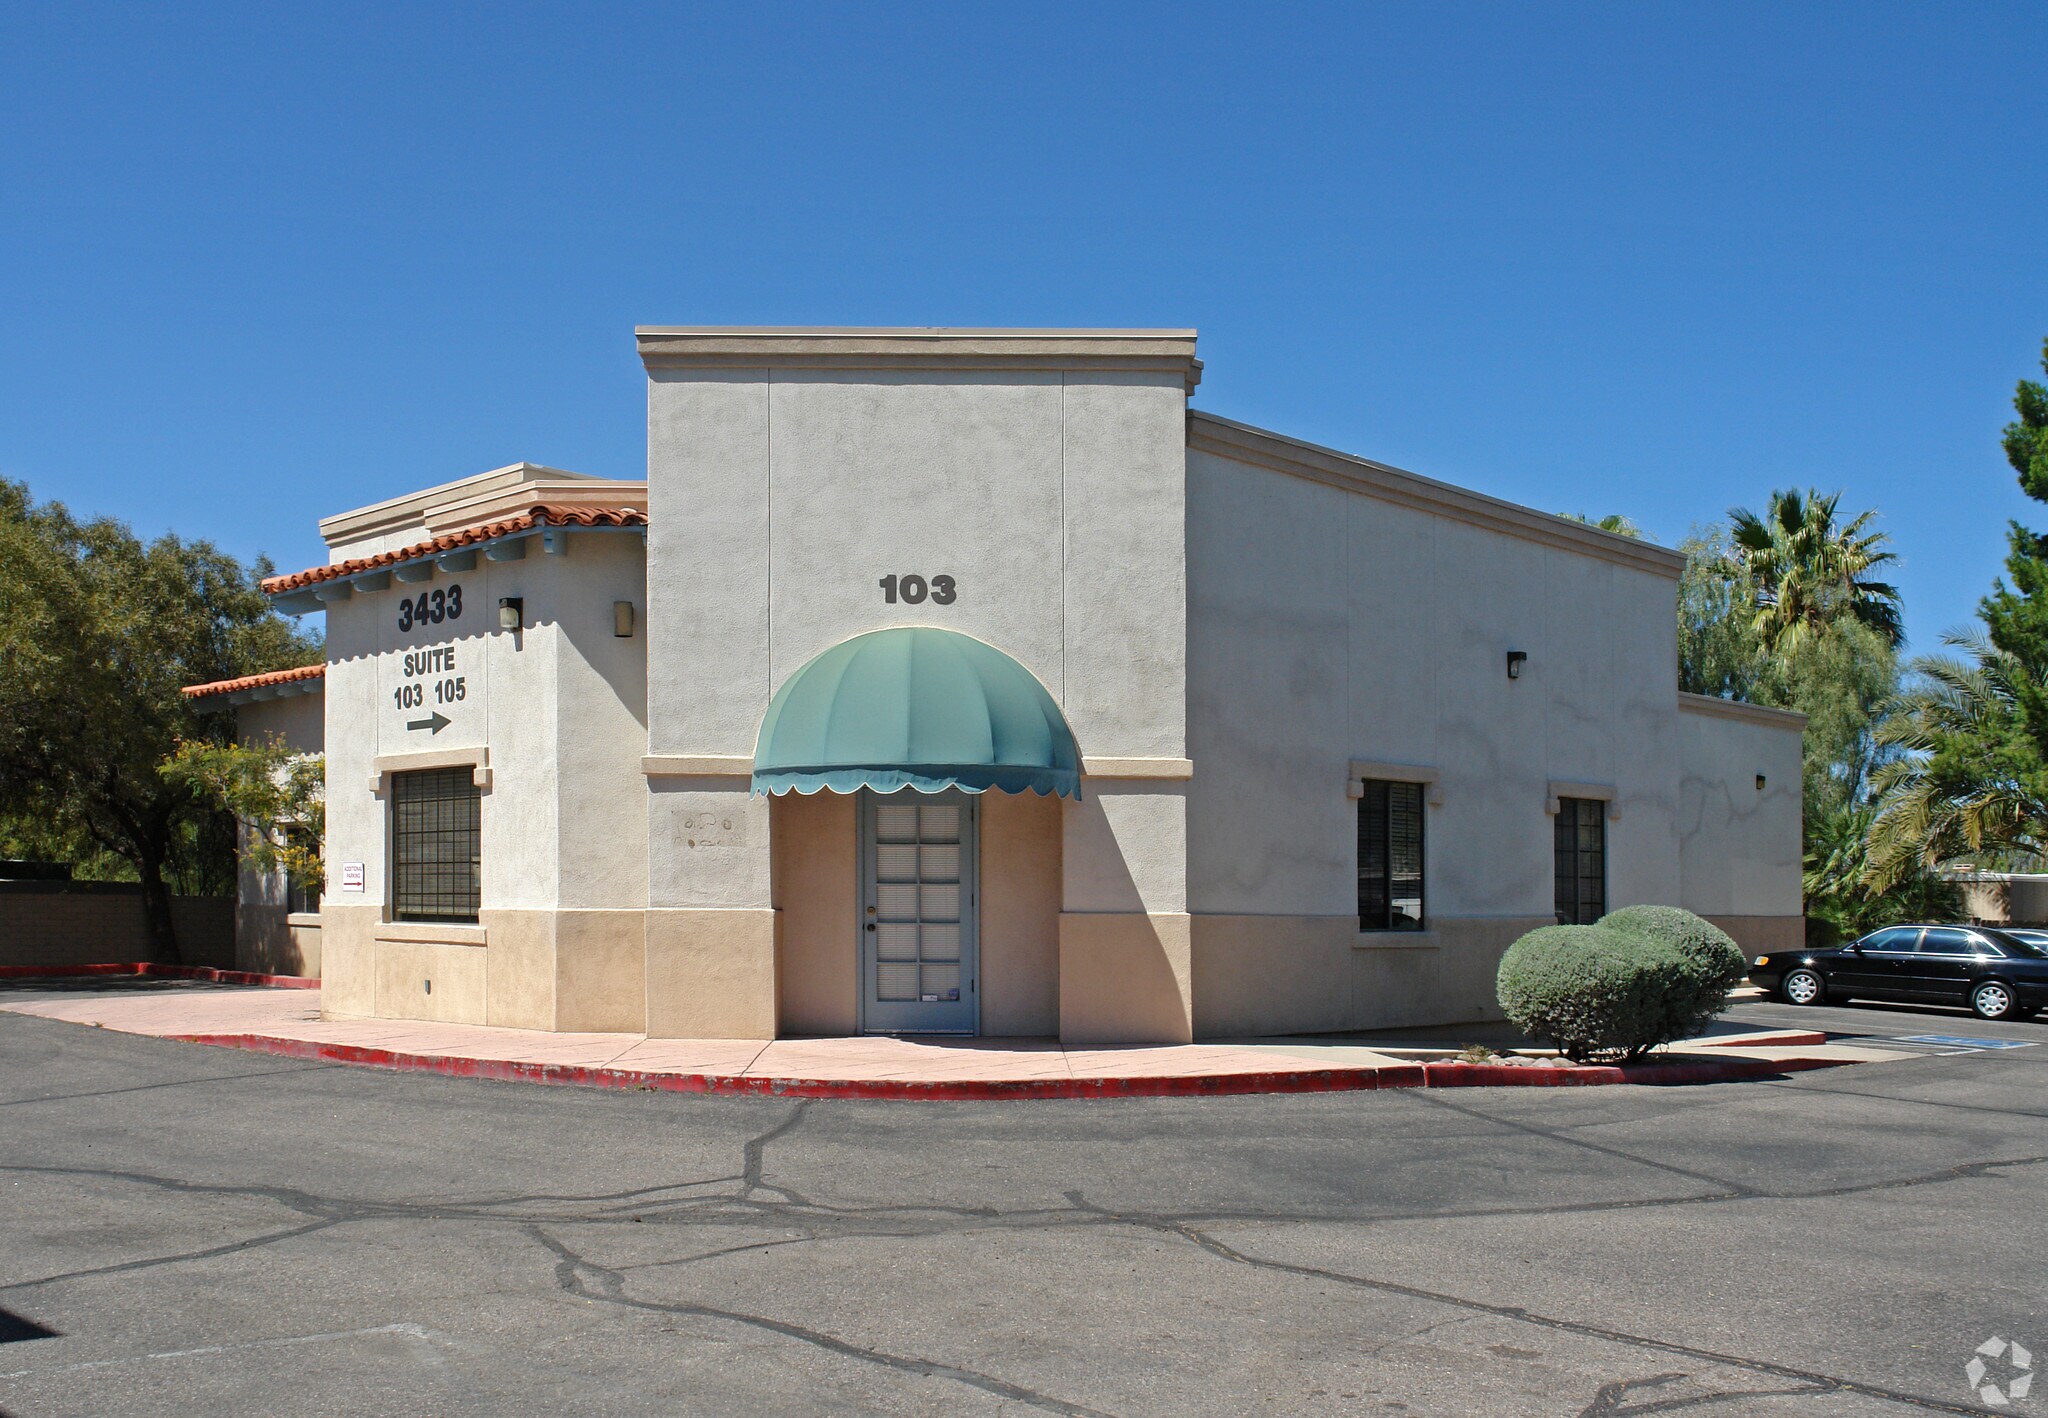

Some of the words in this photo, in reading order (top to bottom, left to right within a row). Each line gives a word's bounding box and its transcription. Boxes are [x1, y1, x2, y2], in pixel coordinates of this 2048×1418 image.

[879, 574, 957, 605] 103
[398, 584, 463, 632] 3433
[404, 646, 455, 677] SUITE
[394, 683, 424, 710] 103
[434, 676, 466, 704] 105
